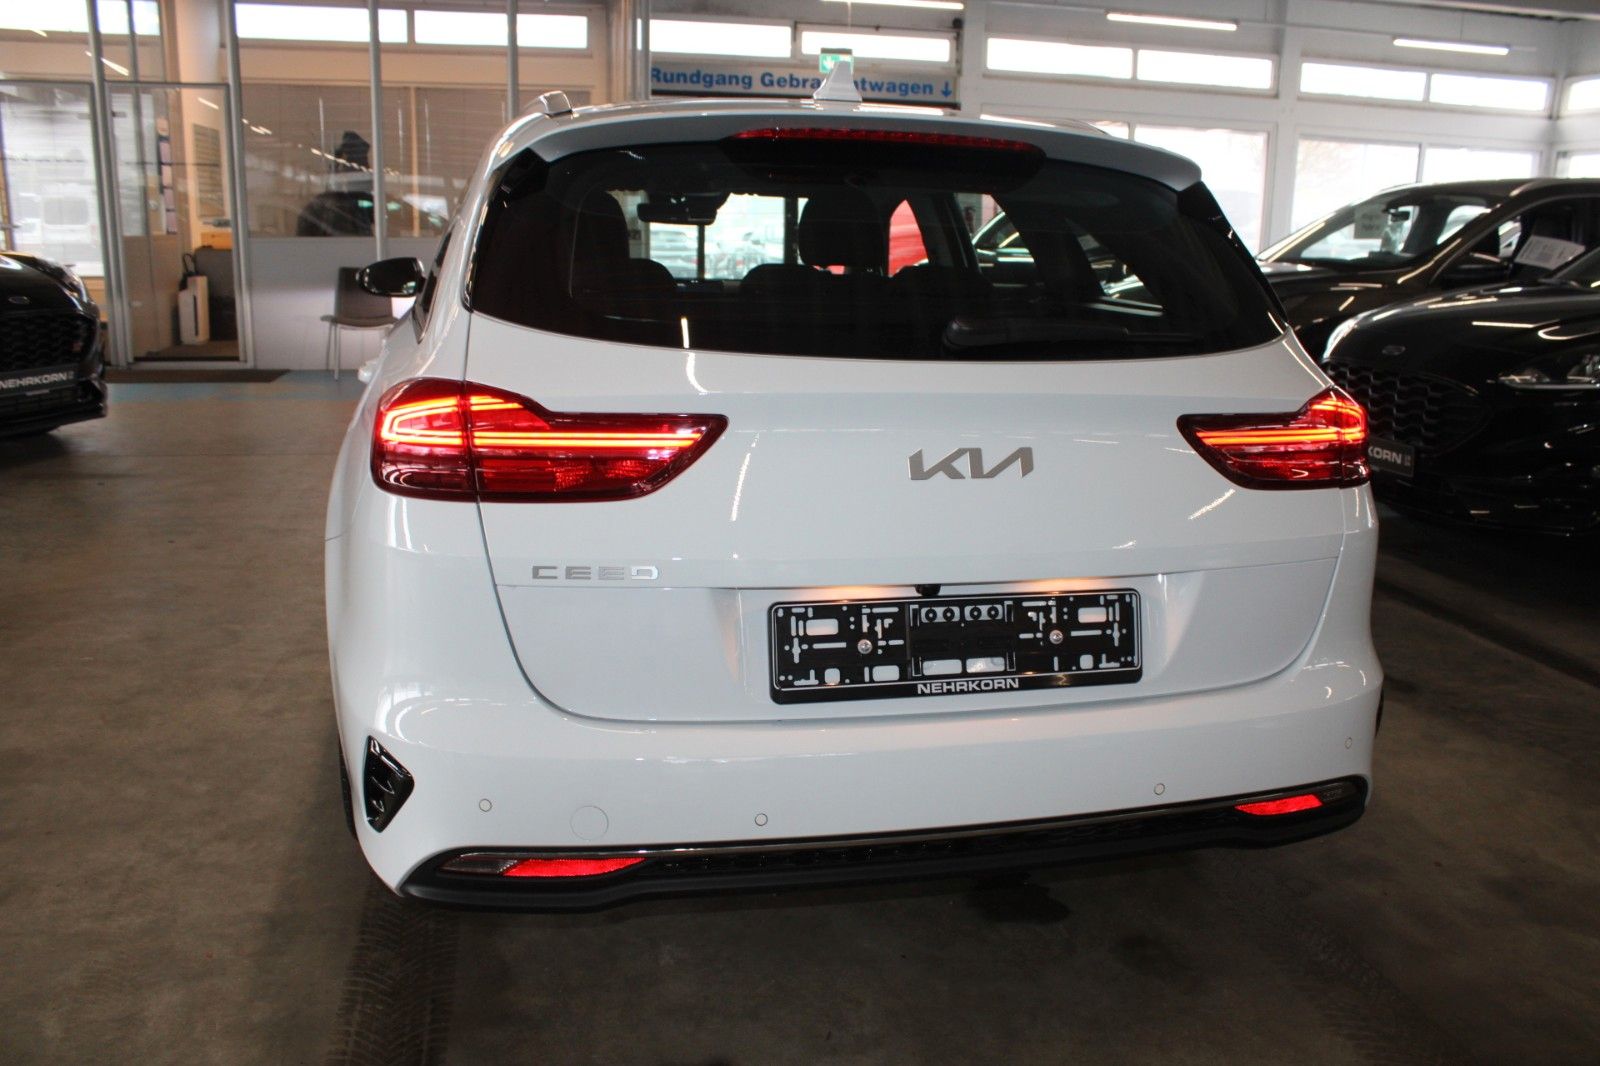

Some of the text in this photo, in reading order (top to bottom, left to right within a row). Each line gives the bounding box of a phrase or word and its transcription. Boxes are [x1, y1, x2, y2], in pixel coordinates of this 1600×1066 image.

[651, 67, 933, 96] Rundgang Gebratwagen
[0, 372, 67, 389] NEHRKORN
[908, 447, 1033, 480] KIA
[532, 565, 659, 580] CEED
[917, 678, 1019, 694] NEHRKORN
